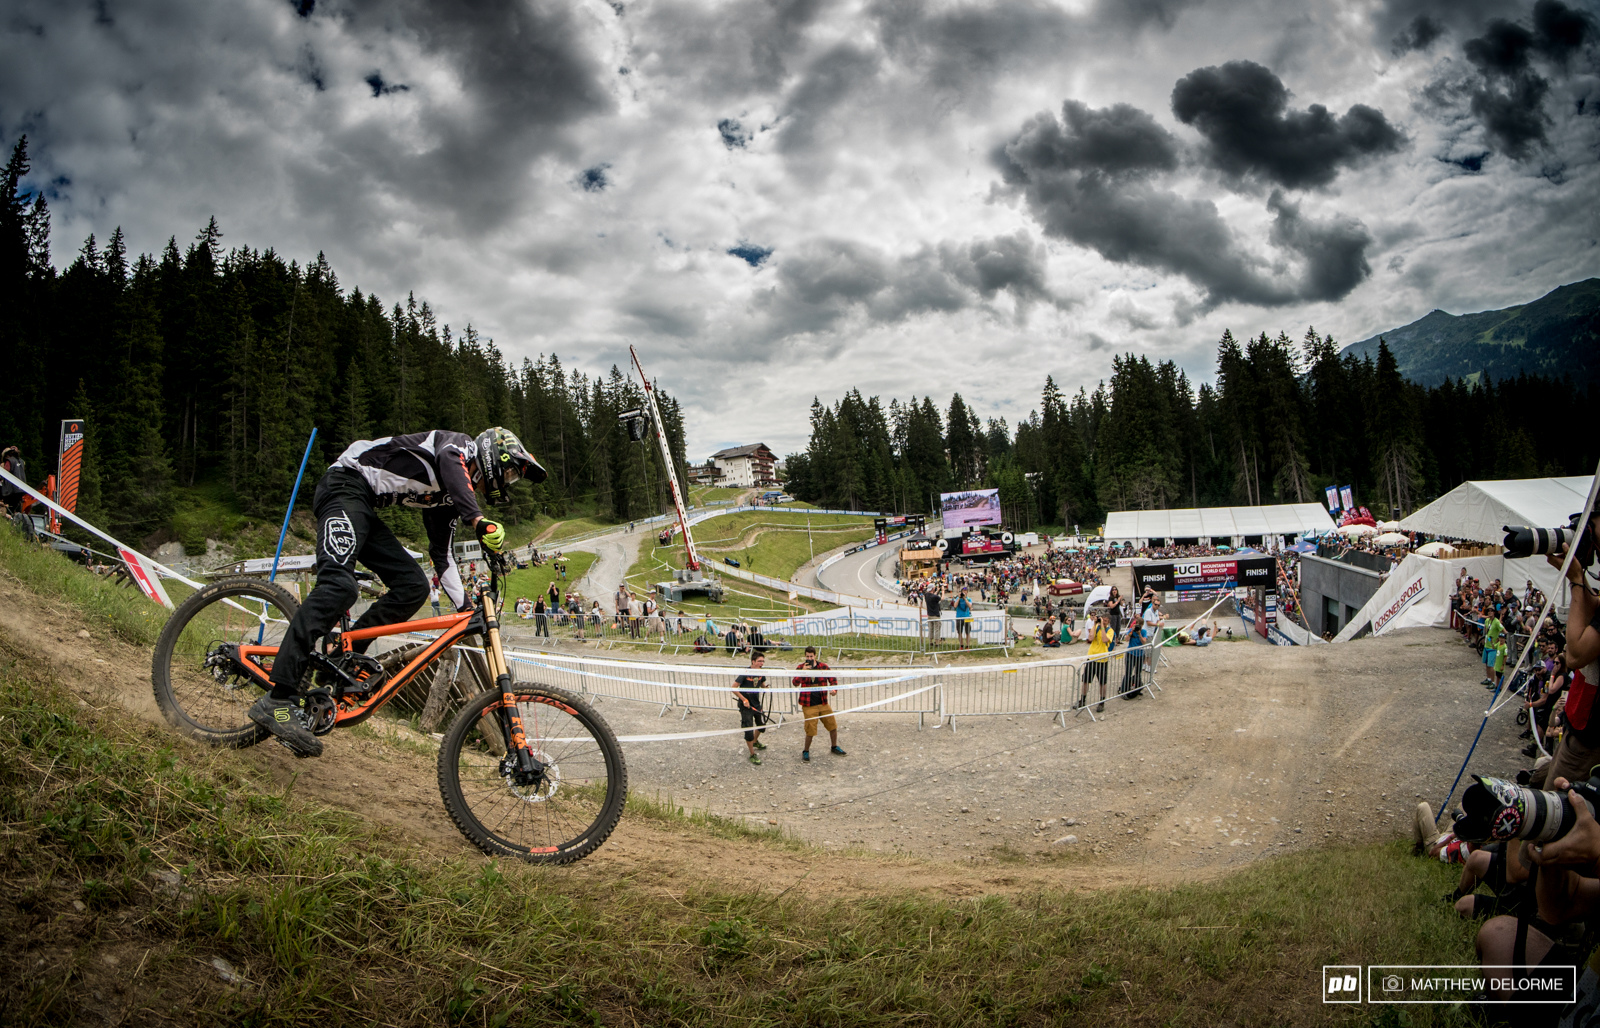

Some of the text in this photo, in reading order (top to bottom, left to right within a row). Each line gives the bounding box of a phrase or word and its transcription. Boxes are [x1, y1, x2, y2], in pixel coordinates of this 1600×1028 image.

[1178, 565, 1199, 575] UCI
[1245, 568, 1268, 577] FINISH
[1142, 574, 1166, 582] FINISH
[1374, 577, 1423, 632] OCHSNER SPORT
[1585, 783, 1598, 791] Canon
[1496, 807, 1511, 824] LONG
